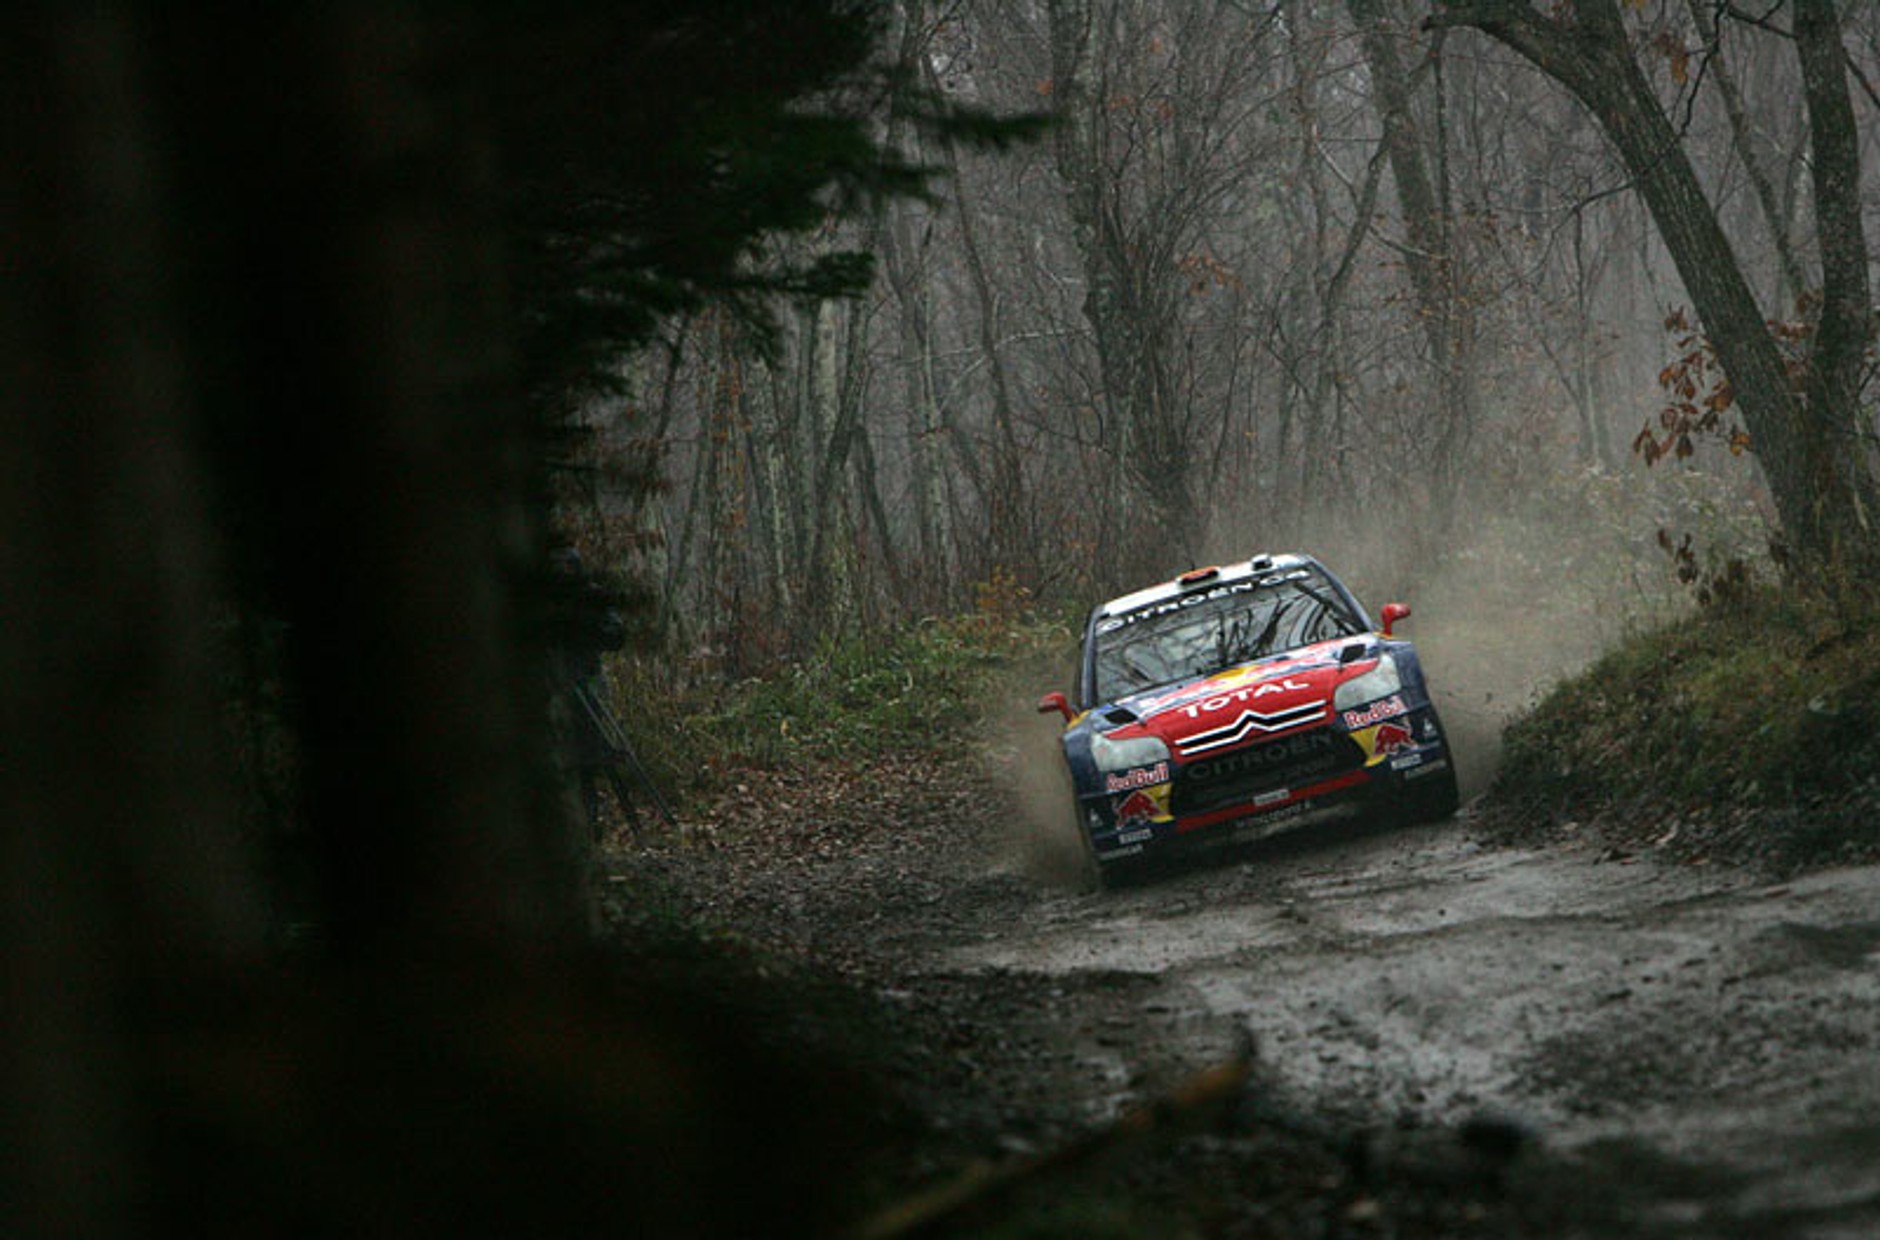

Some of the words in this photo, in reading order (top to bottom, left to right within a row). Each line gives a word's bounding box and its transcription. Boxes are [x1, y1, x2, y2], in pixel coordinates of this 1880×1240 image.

[1177, 679, 1310, 718] TOTAL
[1343, 701, 1380, 729] Red
[1135, 762, 1169, 787] Bull
